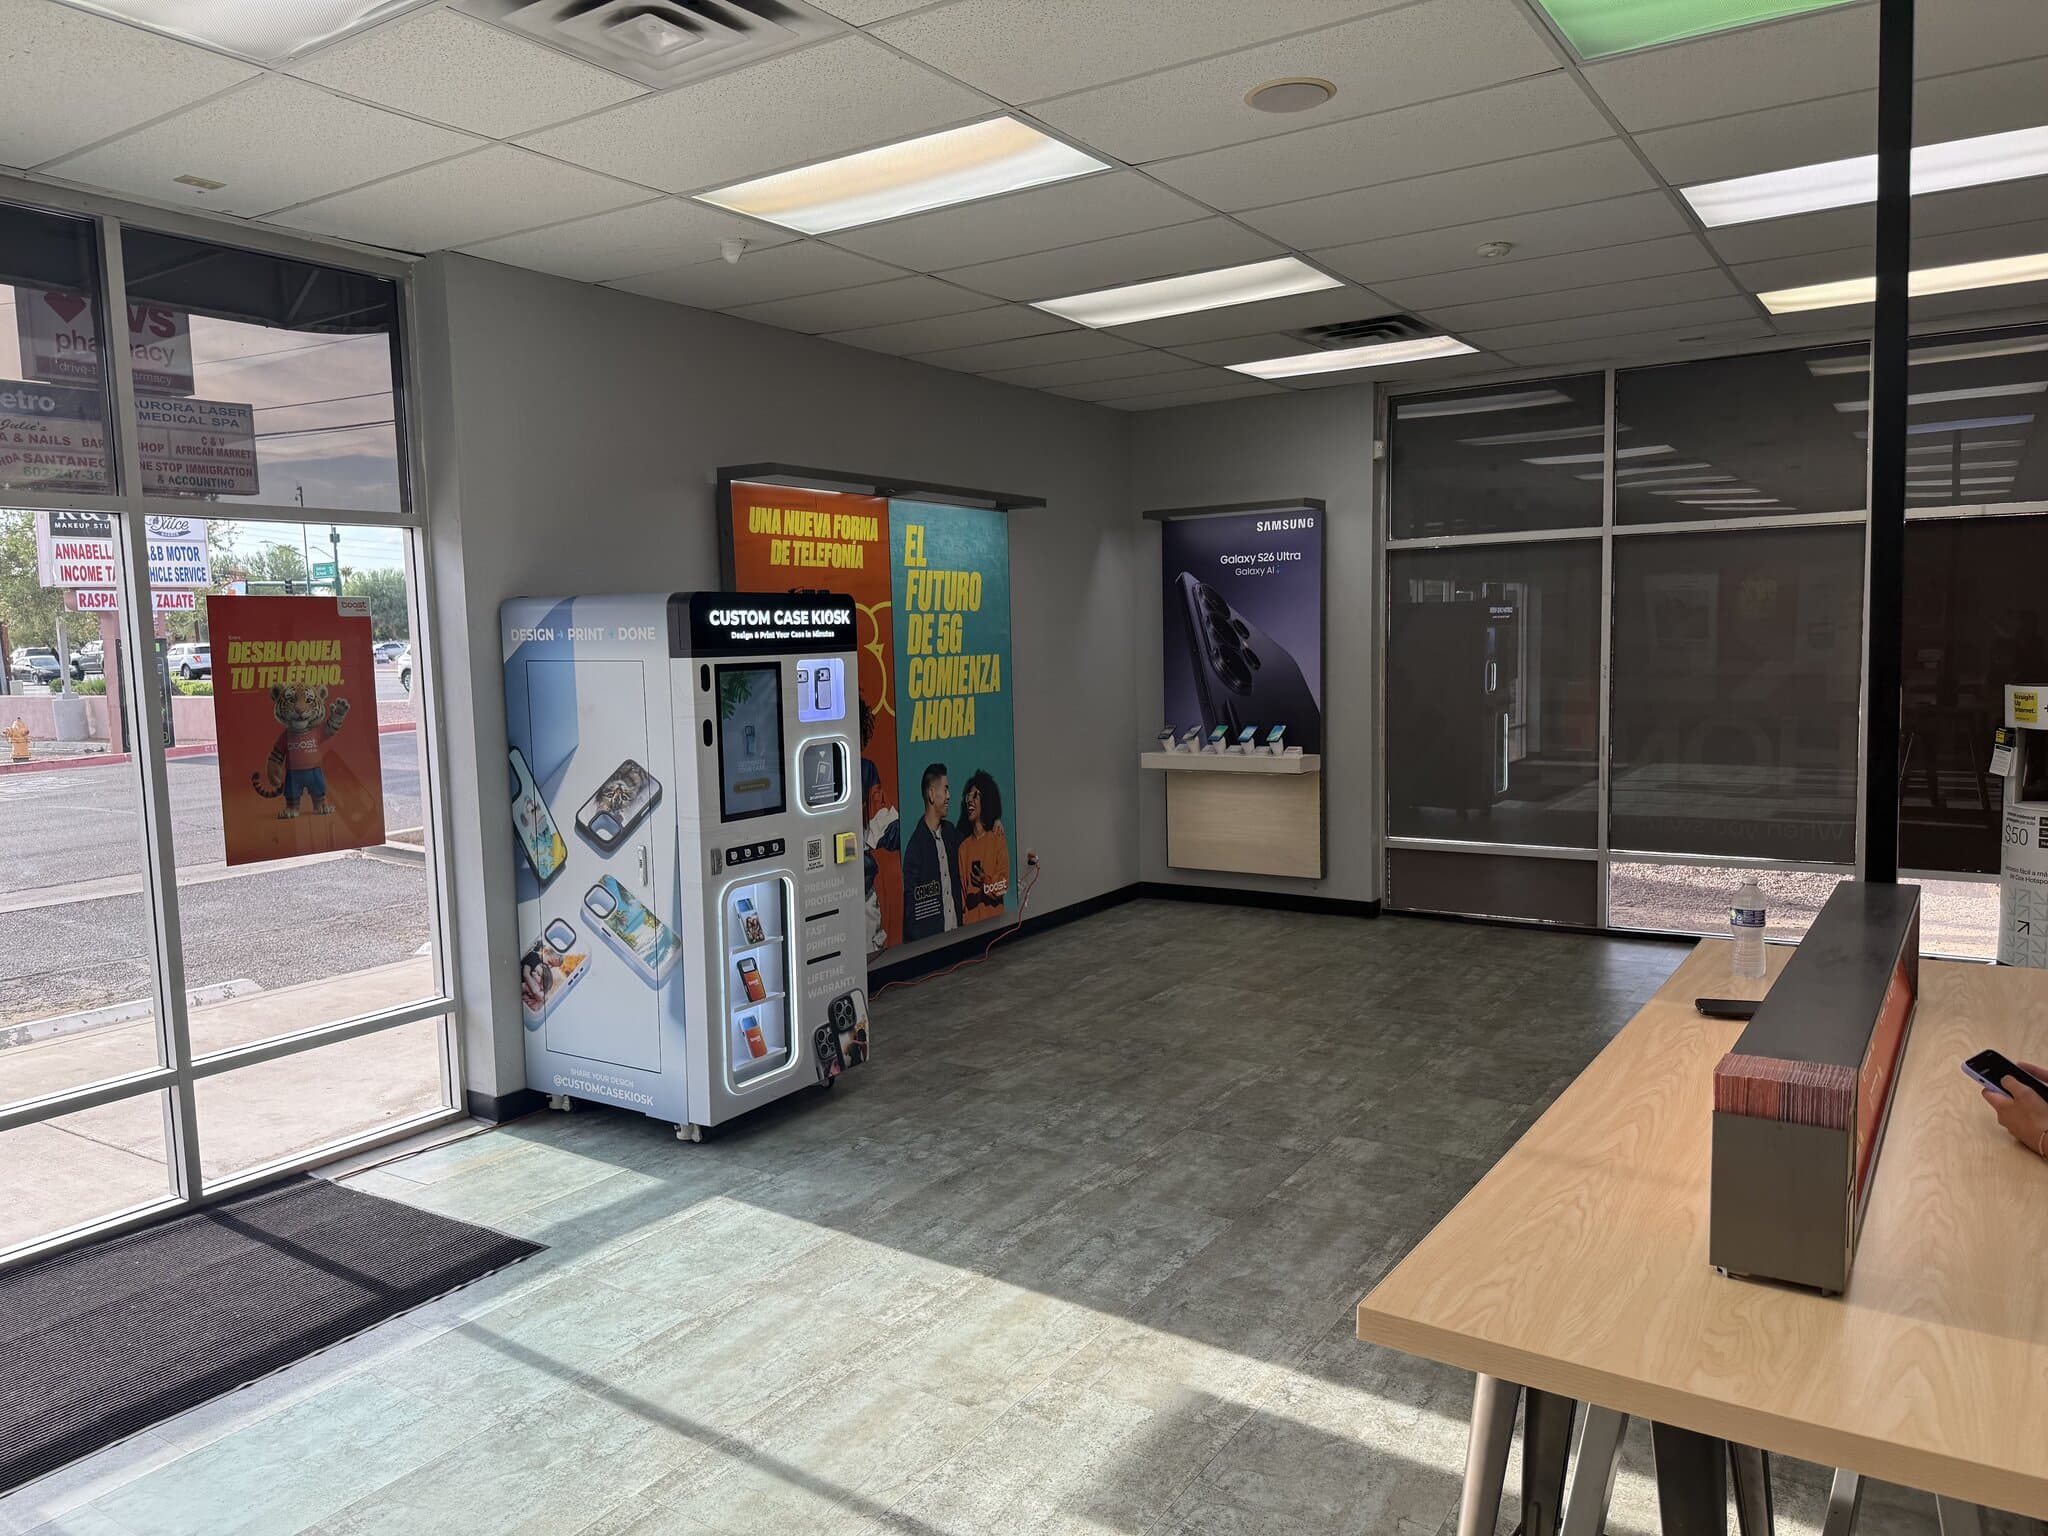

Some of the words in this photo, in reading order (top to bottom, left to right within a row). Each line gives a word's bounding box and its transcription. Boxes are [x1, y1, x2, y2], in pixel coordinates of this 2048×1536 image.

[0, 390, 56, 412] etro
[139, 411, 208, 426] MEDICAL
[211, 417, 239, 428] SPA
[199, 405, 248, 418] LASER
[28, 434, 72, 447] NAILS
[175, 445, 214, 457] AFRICAN
[216, 448, 251, 460] MARKET
[155, 462, 183, 474] STOP
[186, 464, 253, 478] IMMIGRATION
[168, 476, 235, 489] ACCOUNTING
[749, 507, 781, 534] UNA
[784, 510, 831, 539] NUEVA
[834, 514, 878, 542] FORMA
[1256, 518, 1314, 532] SAMSUNG
[166, 546, 201, 562] MOTOR
[770, 540, 791, 566] DE
[793, 540, 864, 569] TELEFONÍA
[904, 525, 927, 567] EL
[1220, 554, 1257, 565] Galaxy
[1257, 552, 1275, 562] S26
[1276, 551, 1302, 561] Ultra
[60, 565, 103, 582] INCOME
[150, 567, 173, 582] HICLE
[174, 567, 207, 582] SERVICE
[1235, 566, 1266, 577] Galaxy
[1267, 566, 1275, 574] AI
[906, 570, 982, 612] FUTURO
[78, 593, 118, 608] RASPA
[156, 594, 194, 608] ZALATE
[709, 610, 770, 626] CUSTOM
[774, 610, 809, 625] CASE
[812, 609, 850, 625] KIOSK
[511, 628, 554, 641] DESIGN
[567, 627, 604, 641] PRINT
[618, 627, 656, 641] DONE
[731, 631, 753, 640] Design
[760, 631, 775, 639] Print
[907, 614, 935, 656] DE
[936, 613, 963, 655] 5G
[228, 640, 342, 664] DESBLOQUEA
[231, 667, 255, 690] TU
[908, 654, 1001, 699] COMIENZA
[910, 697, 976, 743] AHORA
[2005, 823, 2028, 846] $50
[805, 888, 858, 909] PROTECTION
[806, 924, 826, 938] FAST
[807, 935, 846, 952] PRINTING
[807, 965, 845, 985] LIFETIME
[808, 976, 856, 999] WARRANTY
[553, 1074, 654, 1106] @CUSTOMCASEKIOSK
